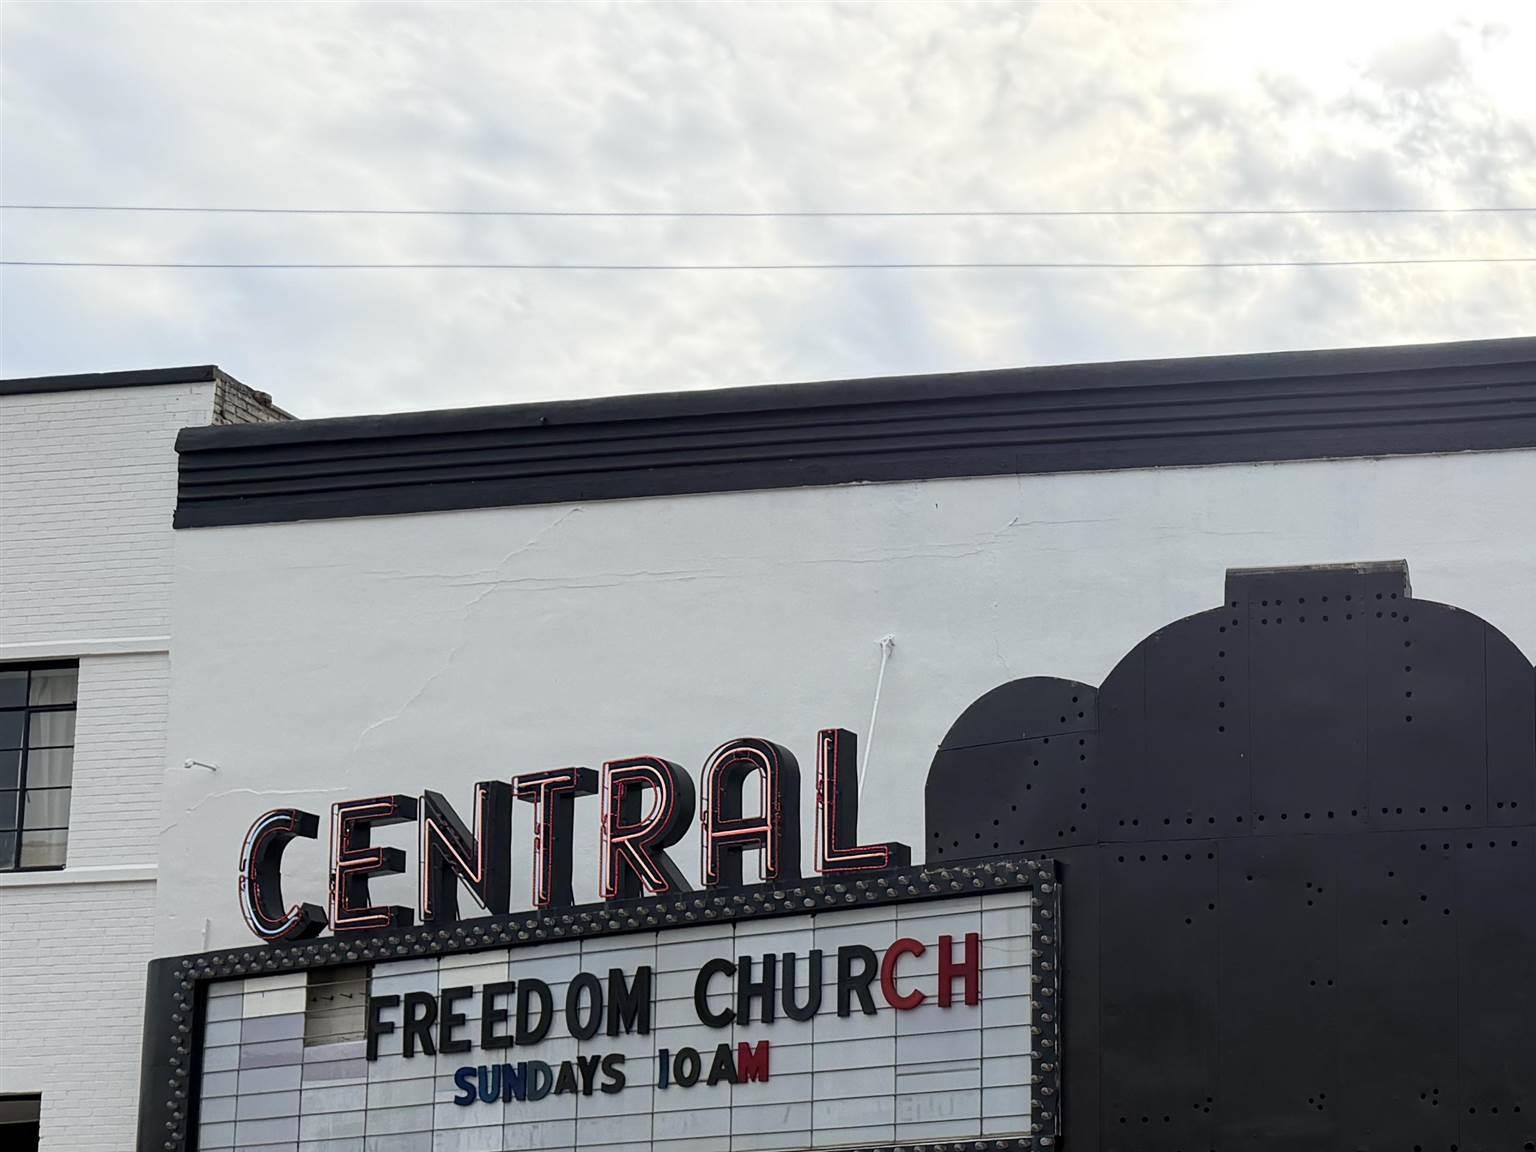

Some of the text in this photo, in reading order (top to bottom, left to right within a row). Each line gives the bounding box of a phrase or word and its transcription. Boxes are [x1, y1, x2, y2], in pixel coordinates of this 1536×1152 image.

[239, 728, 912, 941] CENTRAL
[366, 932, 982, 1061] FREEDOM CHURCH
[453, 1054, 626, 1107] SUNDAYS
